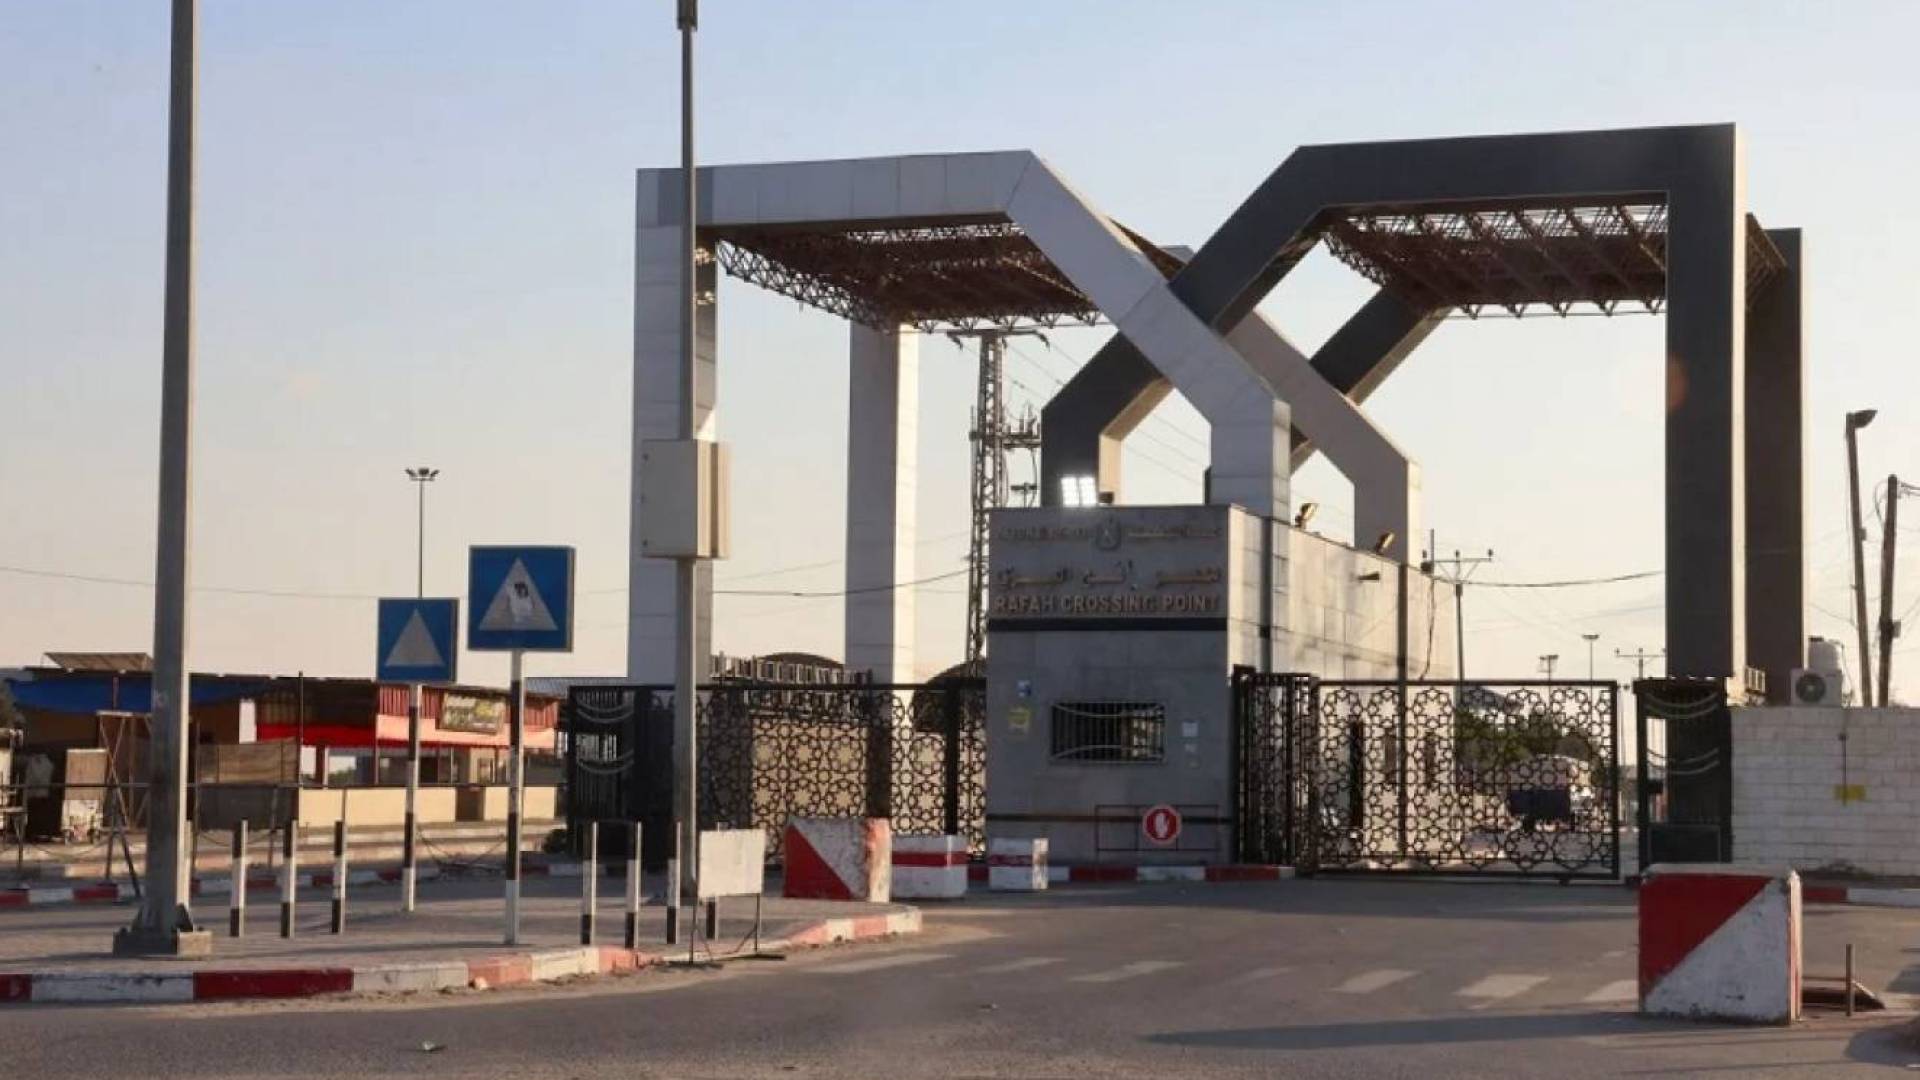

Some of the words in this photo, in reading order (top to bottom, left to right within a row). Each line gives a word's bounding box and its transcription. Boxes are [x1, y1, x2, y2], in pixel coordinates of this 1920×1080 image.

[994, 594, 1054, 614] RAFAH
[1060, 594, 1157, 614] CROSSING
[1163, 593, 1221, 613] POINT
